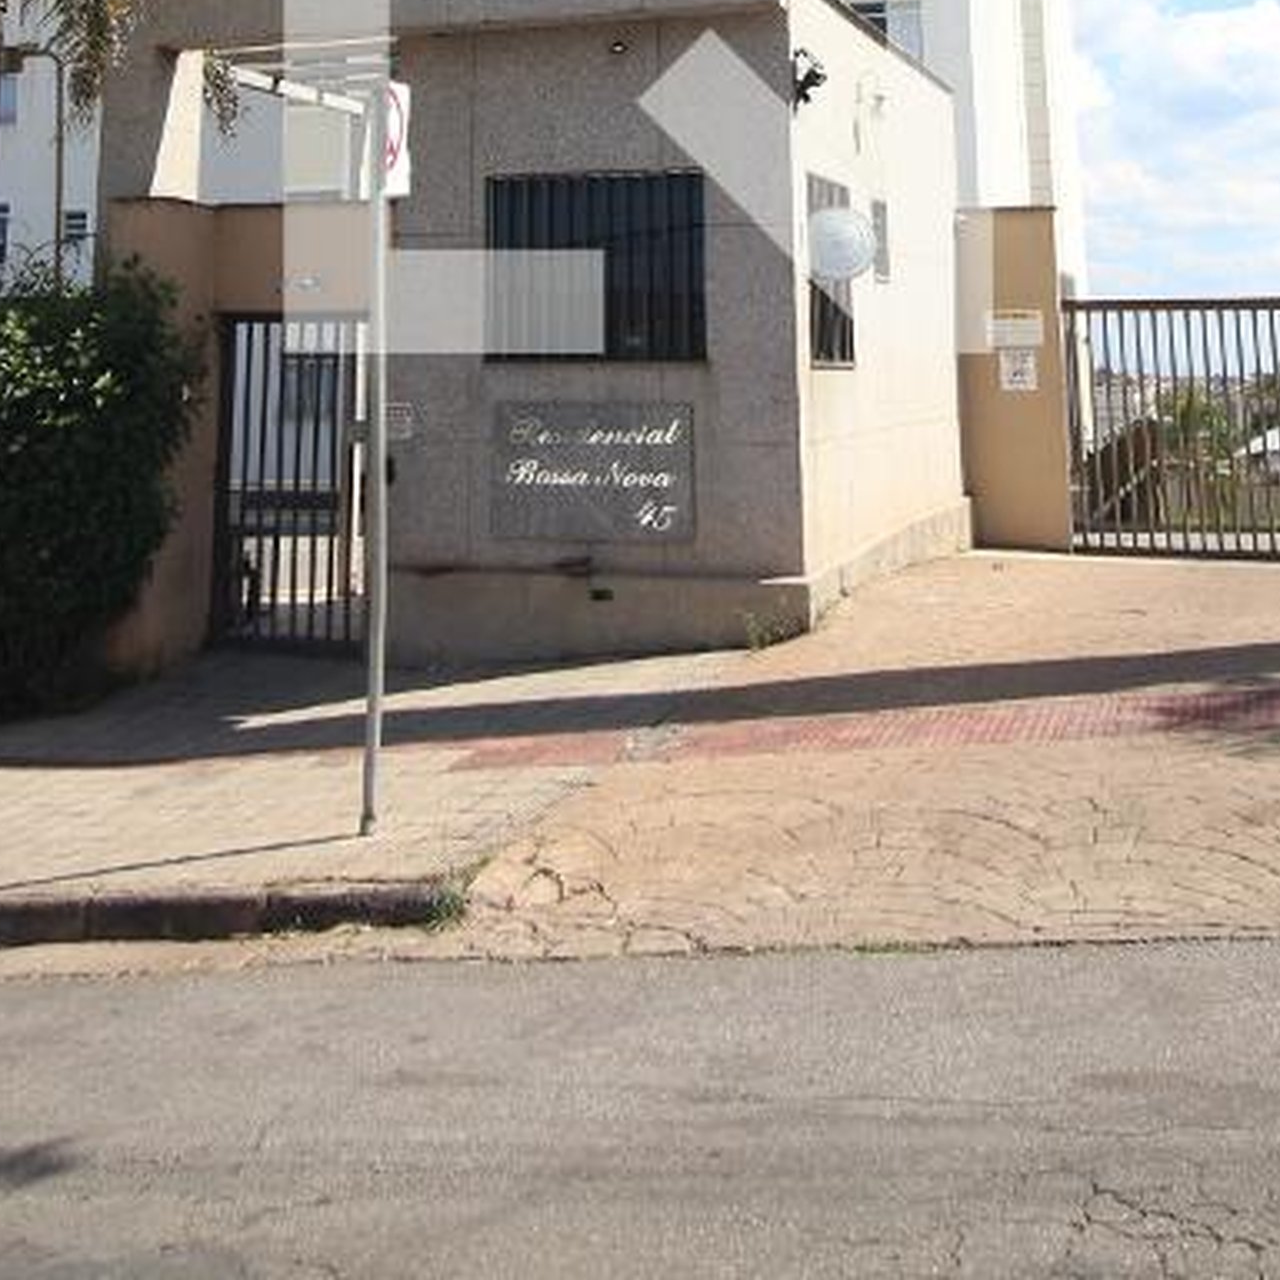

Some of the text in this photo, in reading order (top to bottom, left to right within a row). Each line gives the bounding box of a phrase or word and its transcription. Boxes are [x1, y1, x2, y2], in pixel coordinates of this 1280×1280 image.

[510, 418, 679, 444] Resencial
[506, 459, 676, 488] Bossa Nova
